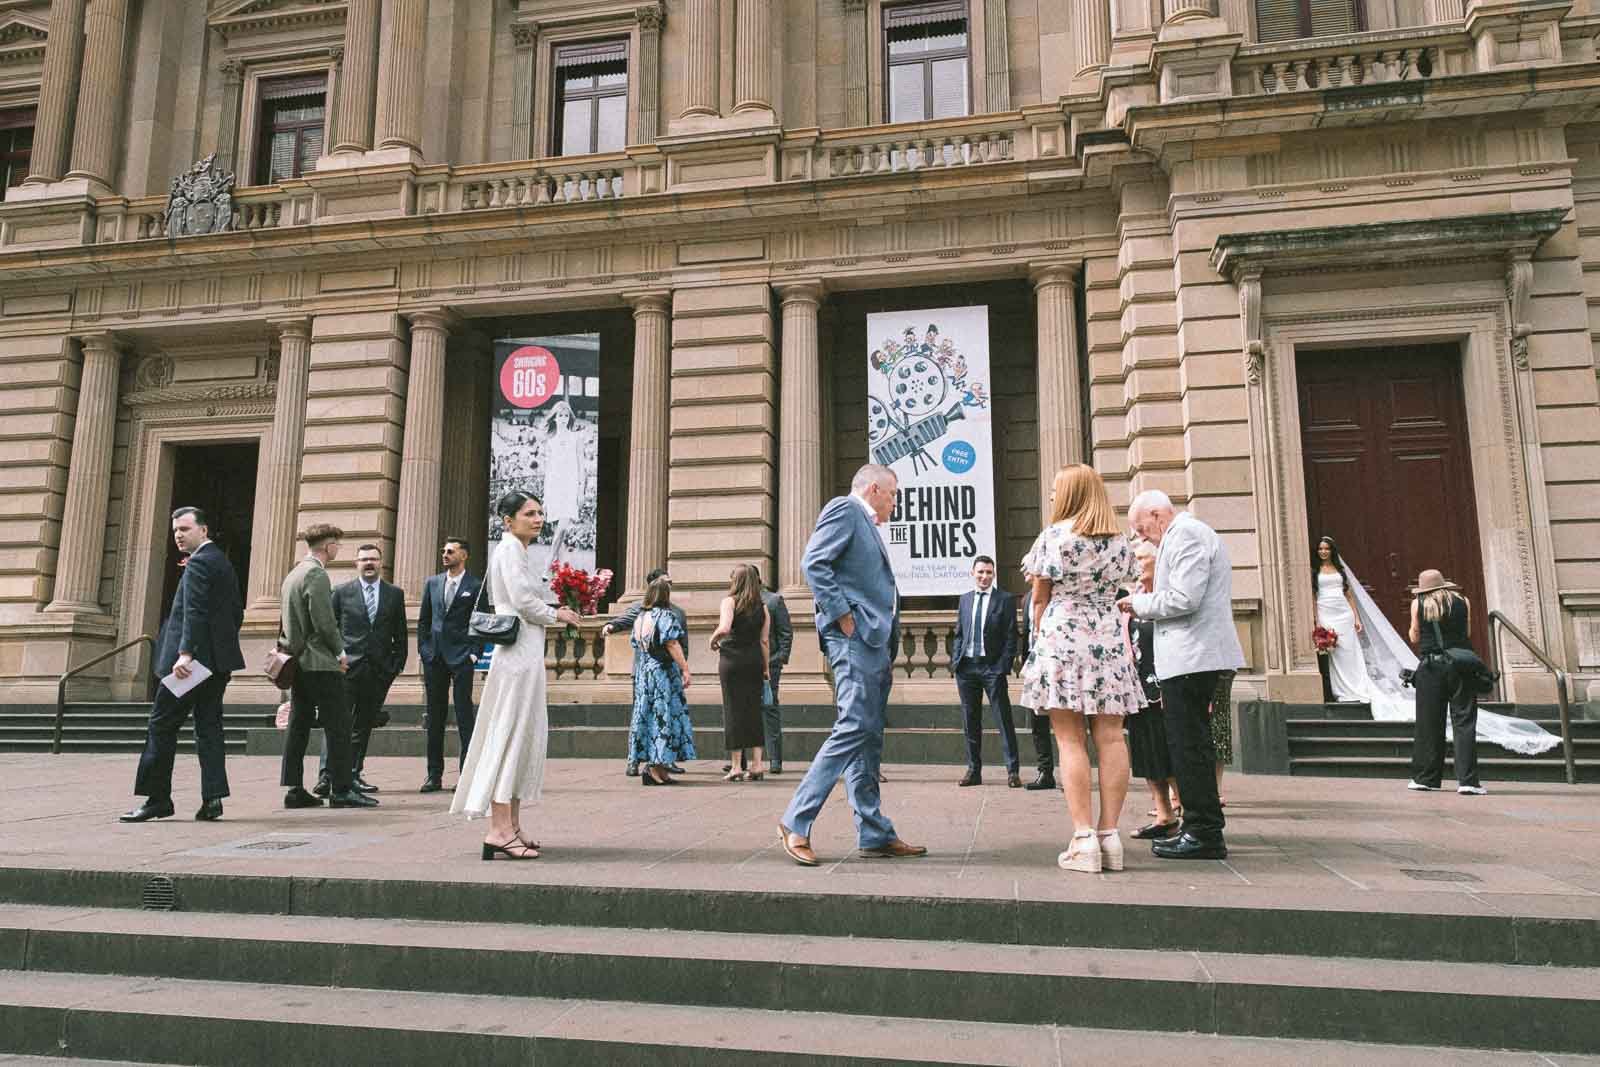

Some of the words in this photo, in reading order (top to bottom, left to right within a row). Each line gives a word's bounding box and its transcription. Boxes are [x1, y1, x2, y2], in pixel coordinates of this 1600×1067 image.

[513, 369, 546, 398] 60s
[947, 456, 969, 464] ENTRY
[952, 448, 968, 457] FREE
[890, 485, 975, 522] BEHIND
[890, 527, 907, 541] THE
[910, 522, 976, 558] LINES
